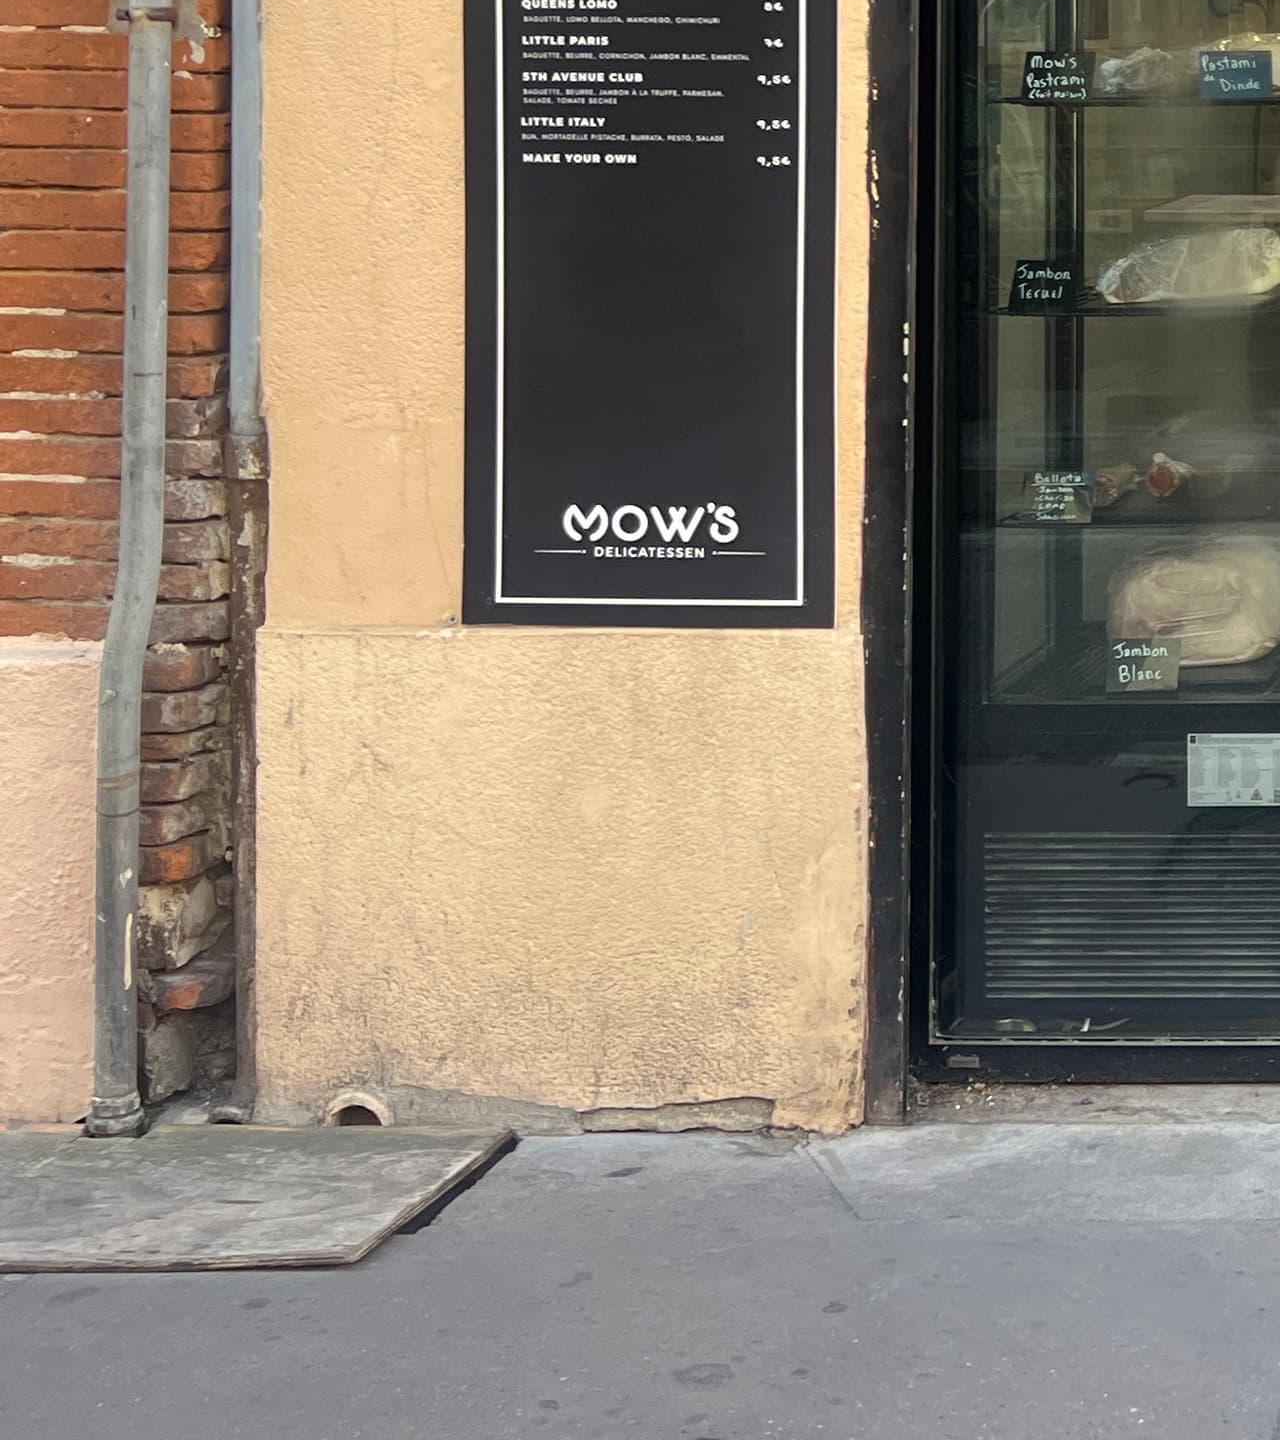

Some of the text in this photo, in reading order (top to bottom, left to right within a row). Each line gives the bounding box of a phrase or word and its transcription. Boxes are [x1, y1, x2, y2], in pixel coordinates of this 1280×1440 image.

[578, 0, 618, 10] LOMO
[521, 35, 609, 46] LITTLE PARIS
[522, 71, 644, 83] 5TH AVENUE CLUB
[1026, 73, 1085, 88] Pastrami
[1220, 78, 1262, 92] Dinde
[520, 116, 606, 128] LITTLE ITALY
[522, 153, 637, 164] MAKE YOUR OWN
[1016, 265, 1072, 280] Jambon
[563, 502, 739, 544] MOW'S
[594, 546, 705, 559] DELICATESSEN
[1112, 642, 1169, 658] Jambon
[1118, 665, 1162, 683] Blanc
